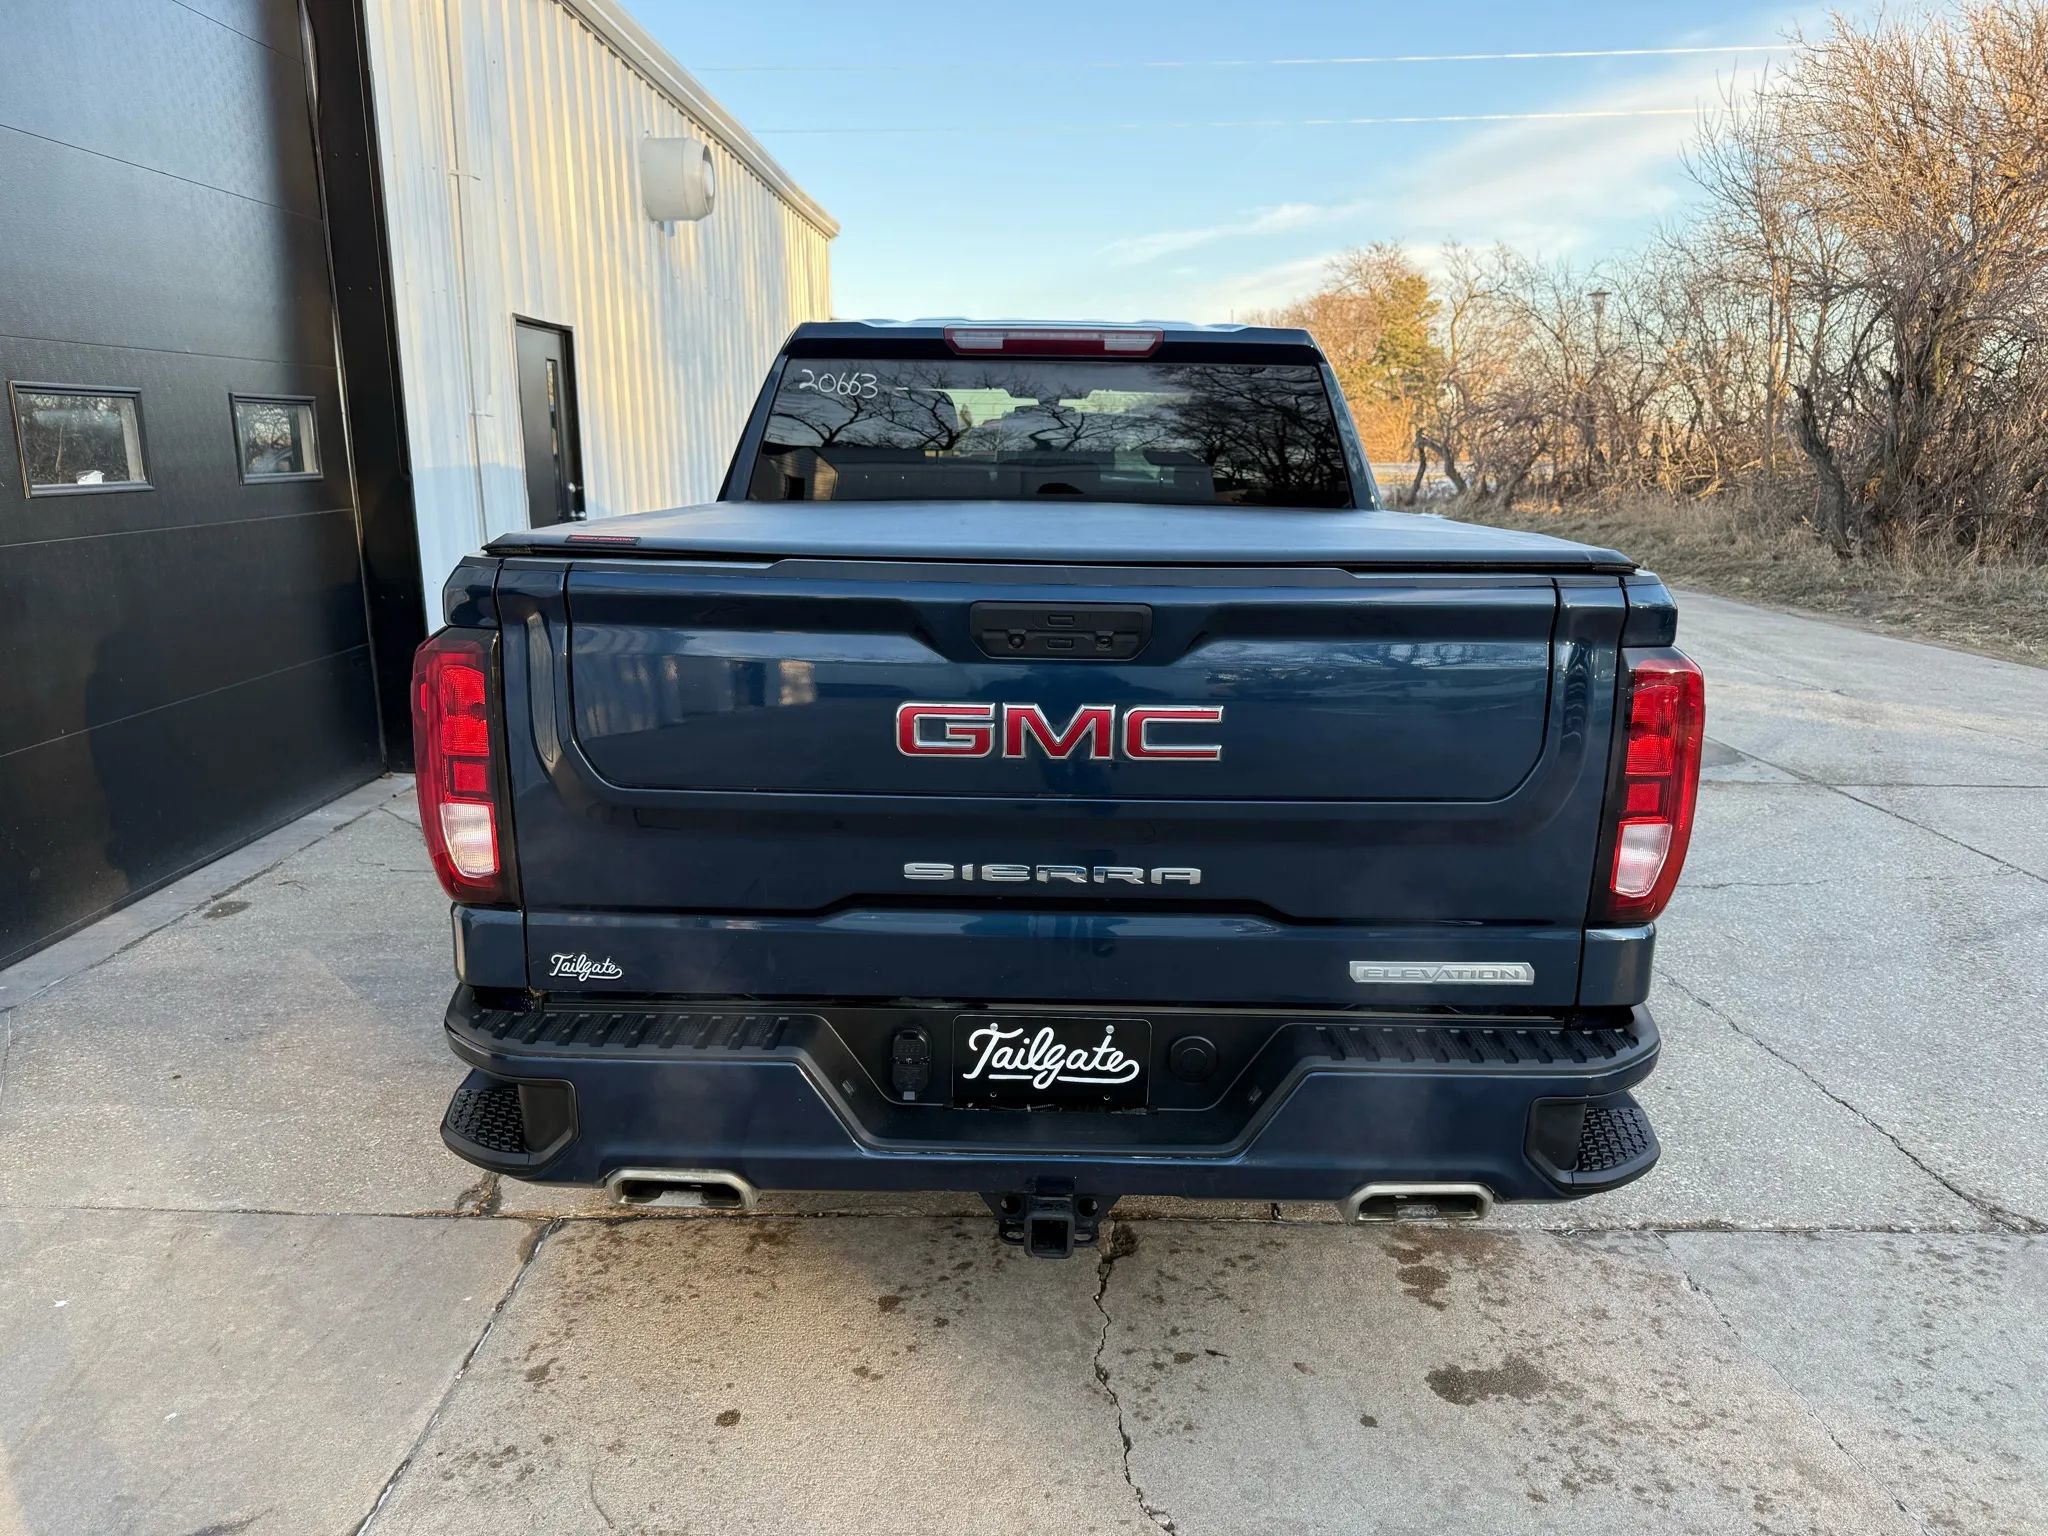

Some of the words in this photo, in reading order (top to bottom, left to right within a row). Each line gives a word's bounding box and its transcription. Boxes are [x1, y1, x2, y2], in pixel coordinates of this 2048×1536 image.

[799, 369, 878, 399] 20663
[896, 702, 1224, 761] GMC
[903, 862, 1202, 885] SIERRA
[549, 954, 623, 982] Tailgate
[1363, 967, 1521, 980] ELEVATION
[962, 1026, 1140, 1090] Tailgate
